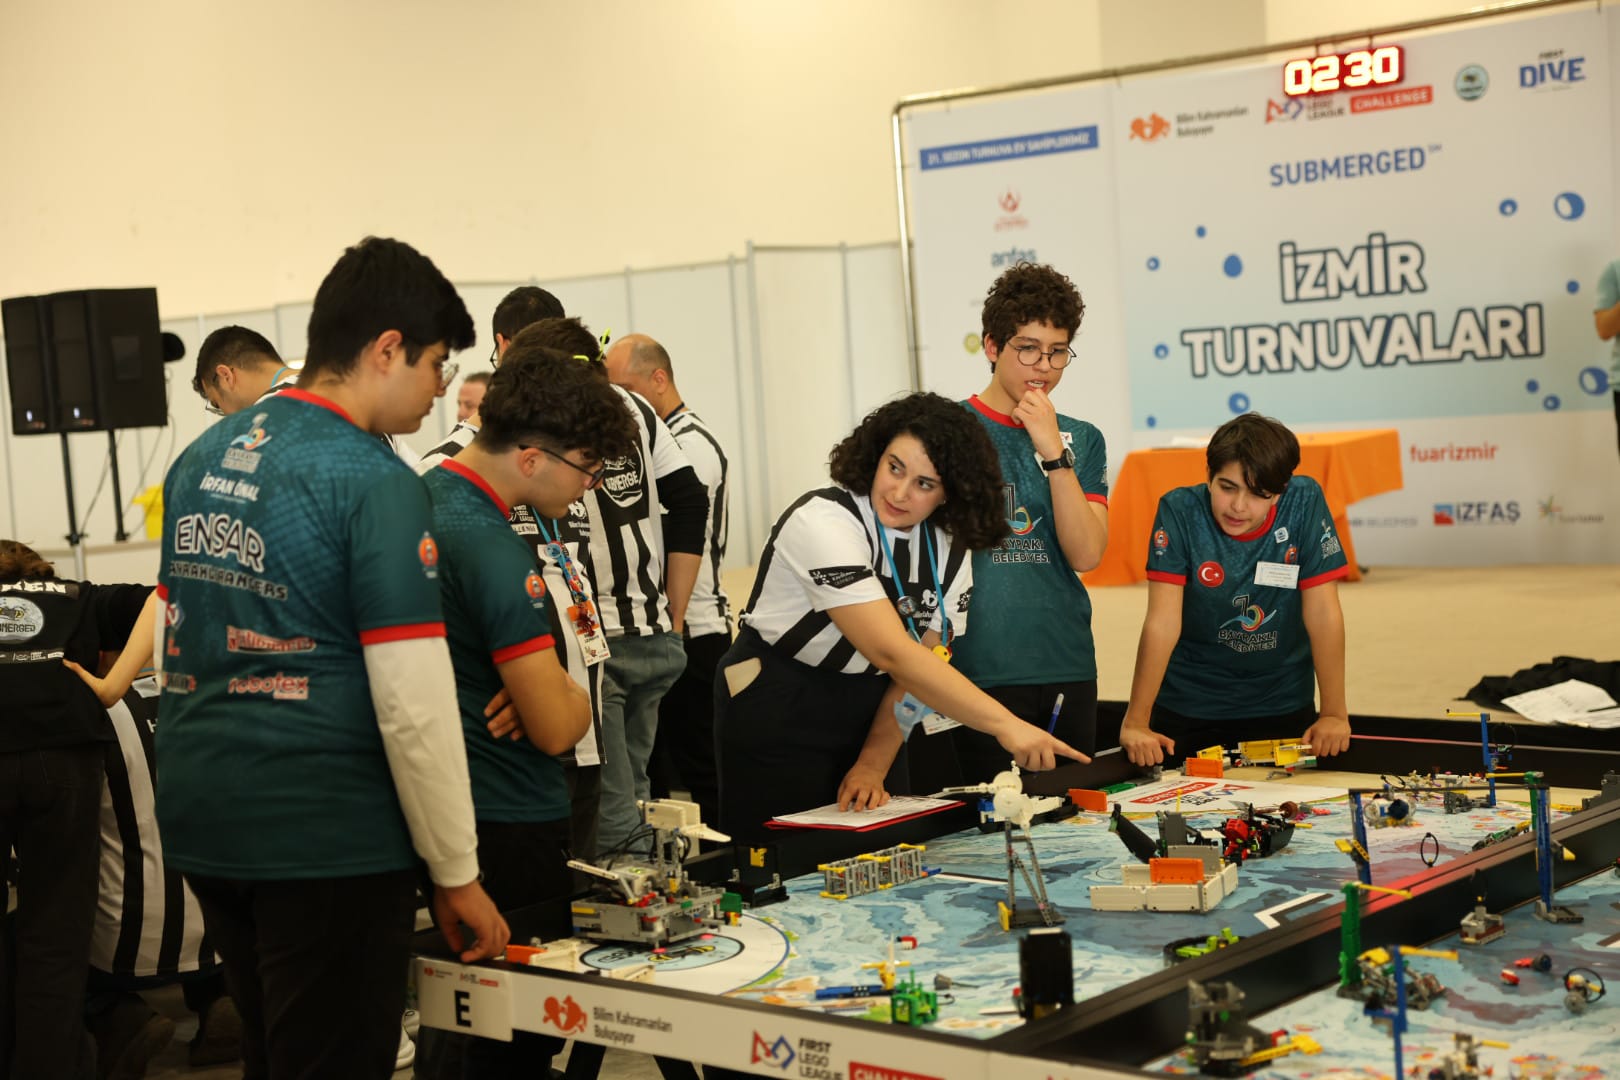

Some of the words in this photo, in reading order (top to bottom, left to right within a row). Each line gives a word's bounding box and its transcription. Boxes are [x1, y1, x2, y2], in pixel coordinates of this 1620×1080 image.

[1519, 57, 1585, 88] DIVE
[1355, 90, 1429, 111] CHALLENGE
[1270, 147, 1426, 187] SUBMERGED
[1279, 232, 1428, 303] İZMİR
[1181, 303, 1545, 378] TURNUVALARI
[1411, 443, 1498, 463] fuarizmir
[1456, 501, 1521, 524] İZFAŞ
[175, 512, 265, 573] ENSAR
[228, 672, 309, 694] robotex
[454, 990, 472, 1028] E
[799, 1037, 831, 1053] FIRST
[799, 1052, 830, 1068] LEGO
[800, 1065, 844, 1080] LEAGUE
